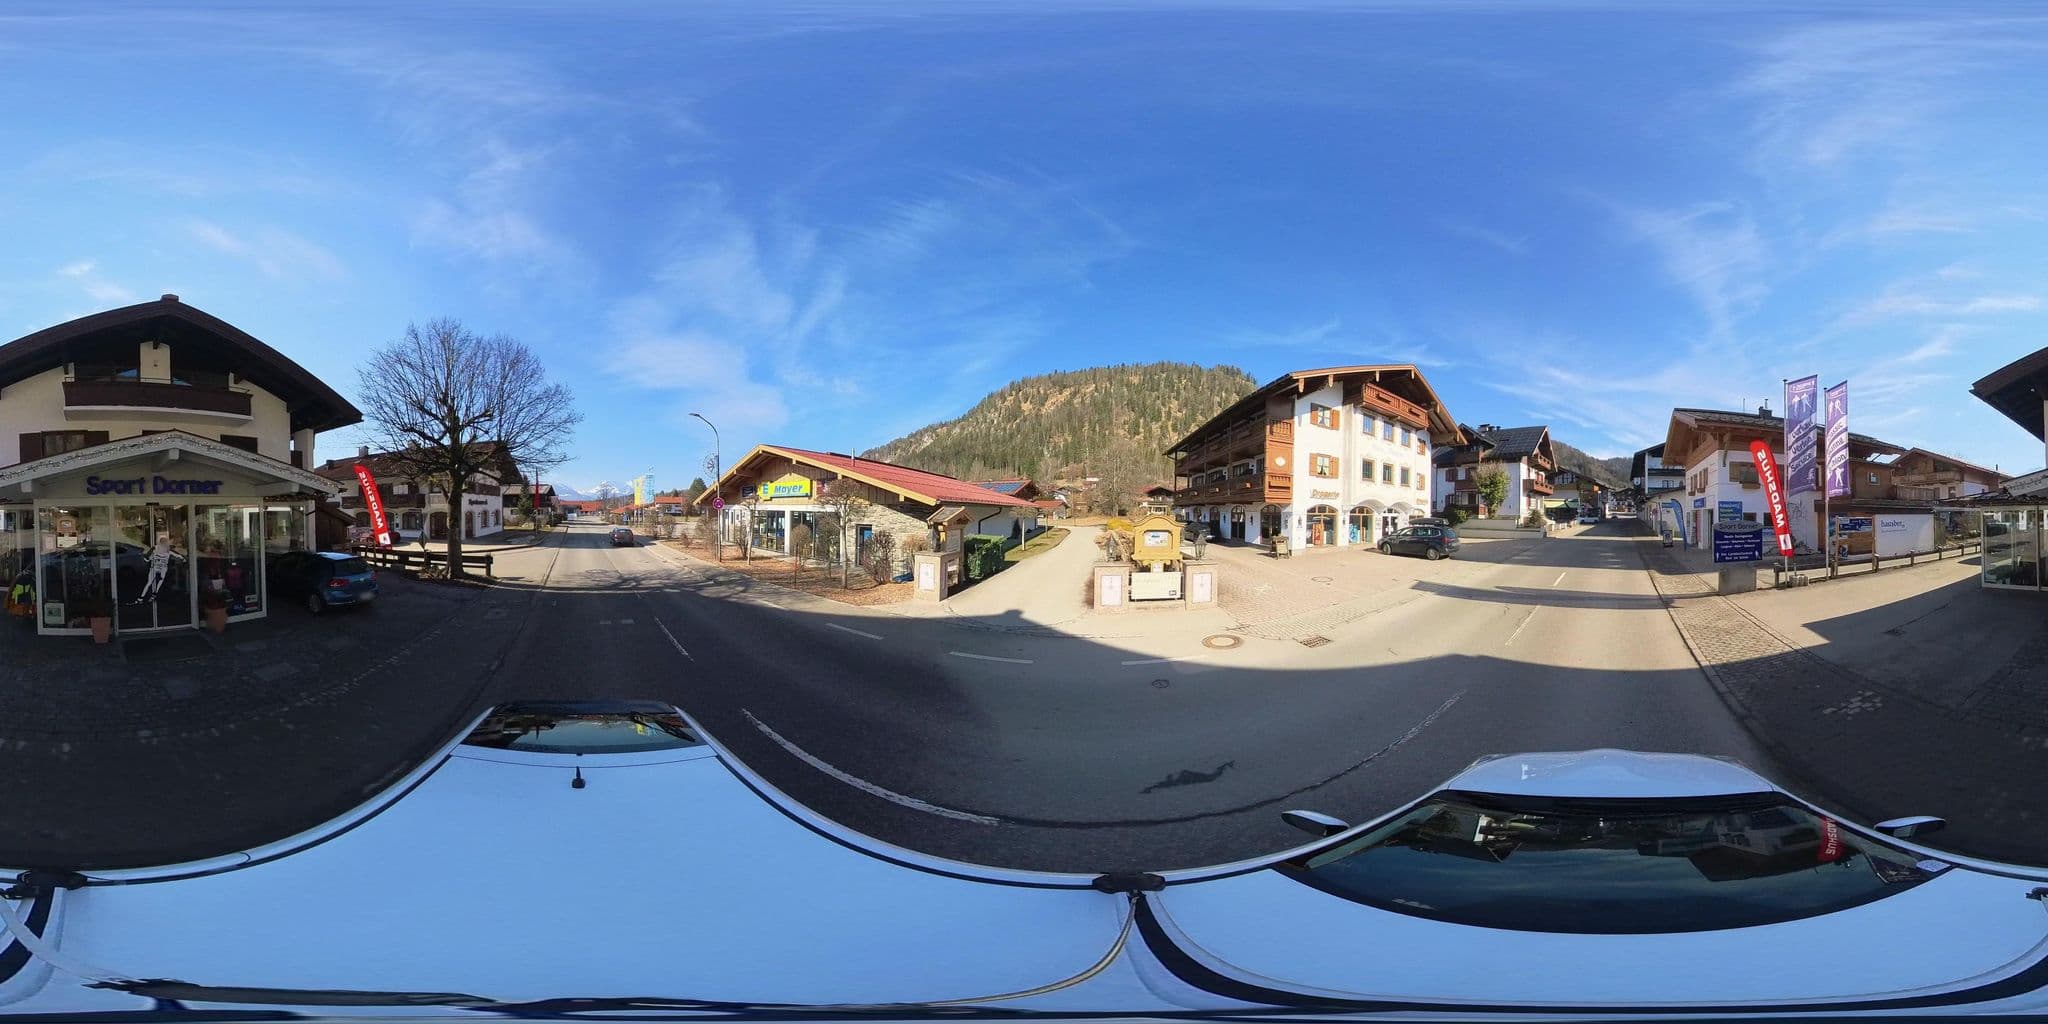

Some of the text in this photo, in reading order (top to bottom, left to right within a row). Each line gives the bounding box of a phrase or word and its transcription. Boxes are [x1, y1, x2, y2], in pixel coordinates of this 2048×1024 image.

[86, 476, 223, 495] Sport Dorner
[774, 484, 803, 494] Mayer
